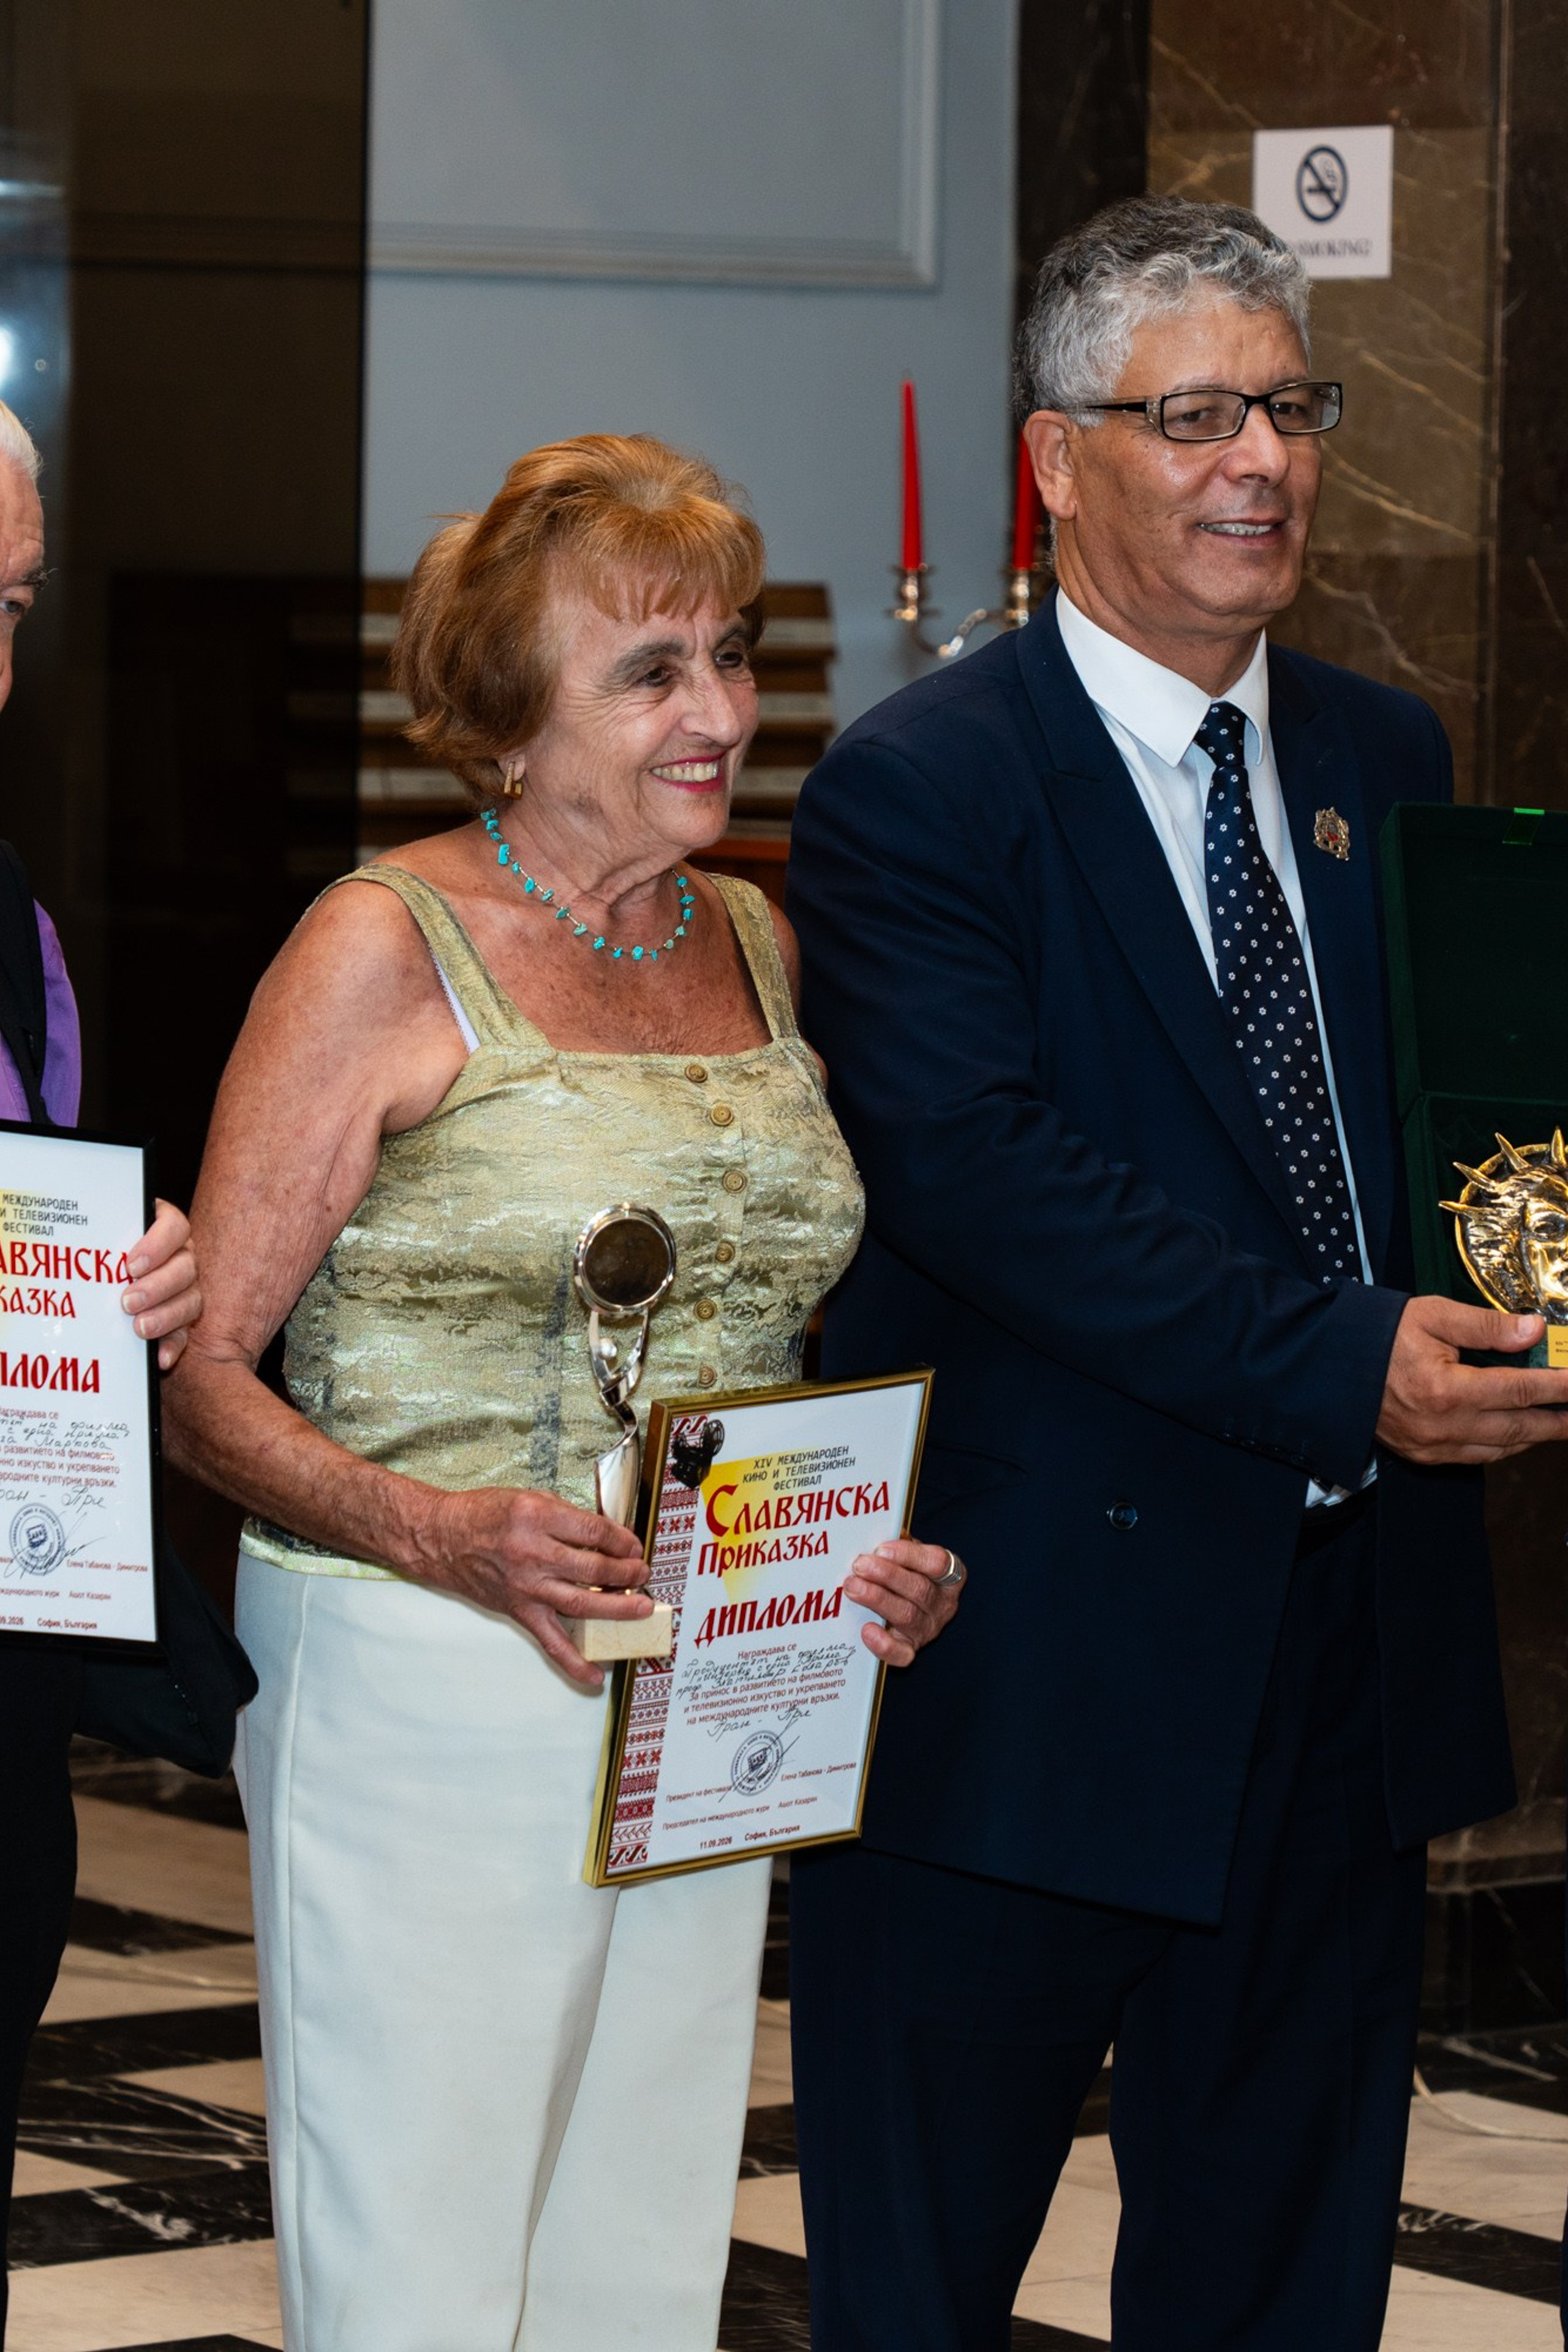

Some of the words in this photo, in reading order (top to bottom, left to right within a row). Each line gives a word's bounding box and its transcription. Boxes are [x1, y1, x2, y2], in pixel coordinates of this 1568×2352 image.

[2, 1193, 78, 1212] МЕЖДУНАРОДЕН
[13, 1208, 88, 1226] ТЕЛЕВИЗИОНЕН
[2, 1222, 54, 1237] ФЕСТИВАЛ
[4, 1446, 53, 1457] развитието
[55, 1449, 66, 1457] на
[753, 1458, 772, 1469] XIV
[777, 1446, 849, 1465] МЕЖДУНАРОДЕН
[17, 1460, 56, 1471] изкуство
[67, 1463, 120, 1474] укрепването
[742, 1471, 767, 1483] КИНО
[772, 1469, 780, 1479] И
[786, 1457, 856, 1477] ТЕЛЕВИЗИОНЕН
[42, 1475, 82, 1487] културни
[773, 1475, 822, 1491] ФЕСТИВАЛ
[694, 1586, 844, 1649] ДИПЛОМА
[737, 1646, 785, 1660] Награждава
[688, 1691, 699, 1702] За
[701, 1687, 730, 1700] принос
[739, 1678, 786, 1694] развитието
[787, 1676, 797, 1684] на
[799, 1668, 843, 1684] филмовото
[692, 1696, 748, 1713] телевизионно
[750, 1689, 786, 1702] изкуство
[796, 1679, 846, 1697] укрепването
[687, 1717, 696, 1726] на
[698, 1704, 769, 1722] международните
[771, 1698, 809, 1713] културни
[769, 1825, 801, 1837] България
